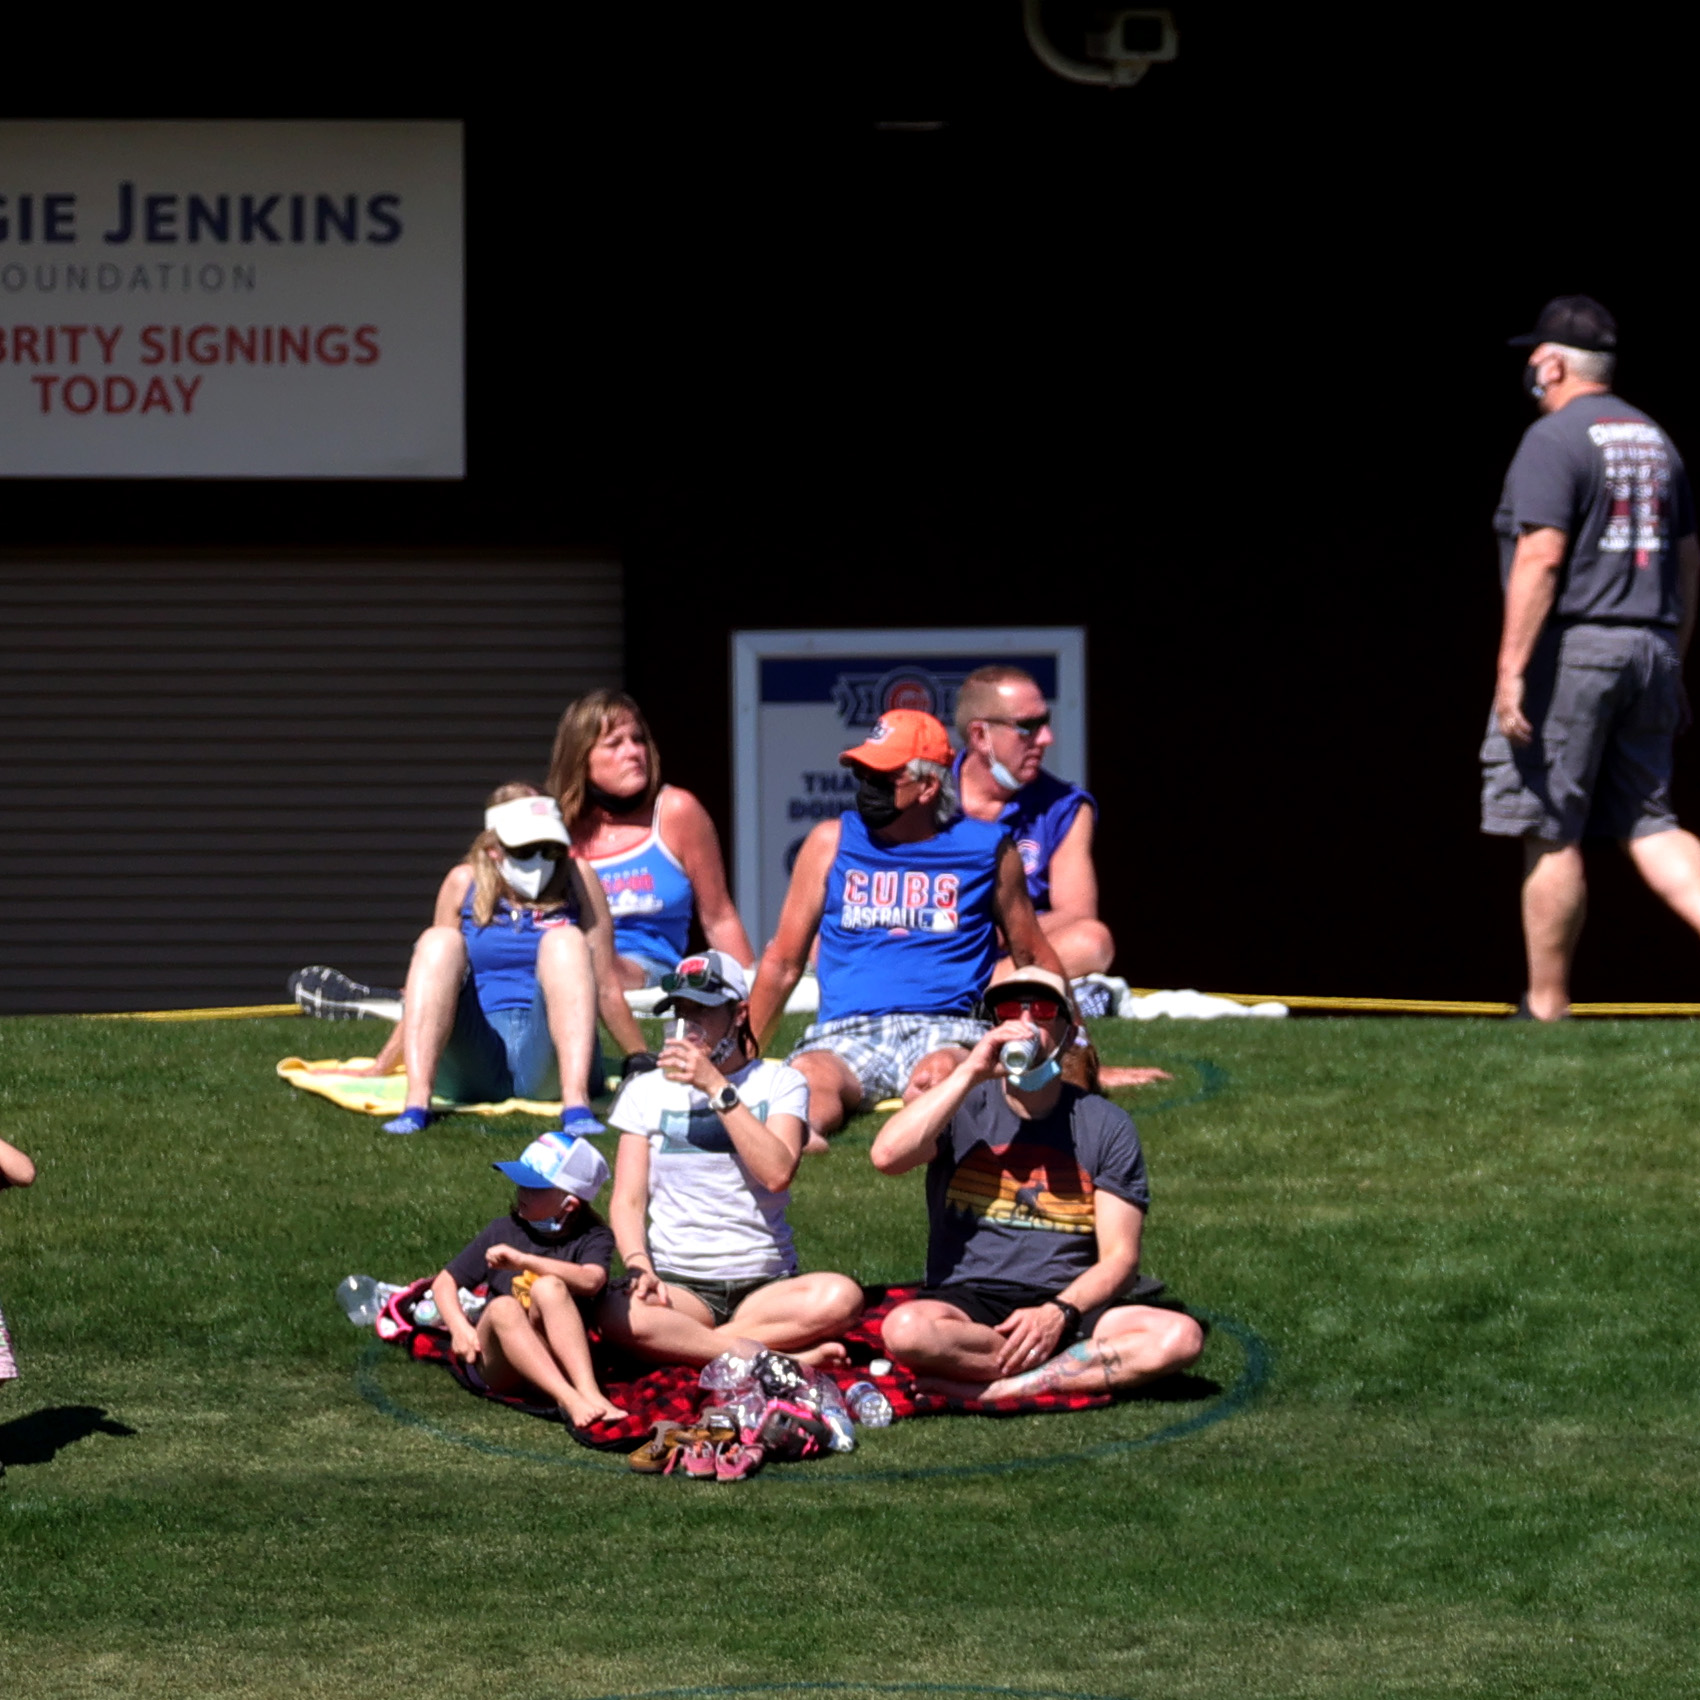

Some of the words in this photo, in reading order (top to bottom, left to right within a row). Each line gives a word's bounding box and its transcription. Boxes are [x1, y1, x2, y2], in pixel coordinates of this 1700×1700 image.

[0, 193, 76, 244] IE
[104, 182, 404, 245] JENKINS
[140, 324, 381, 365] SIGNINGS
[32, 375, 203, 415] TODAY
[844, 869, 960, 910] CUBS
